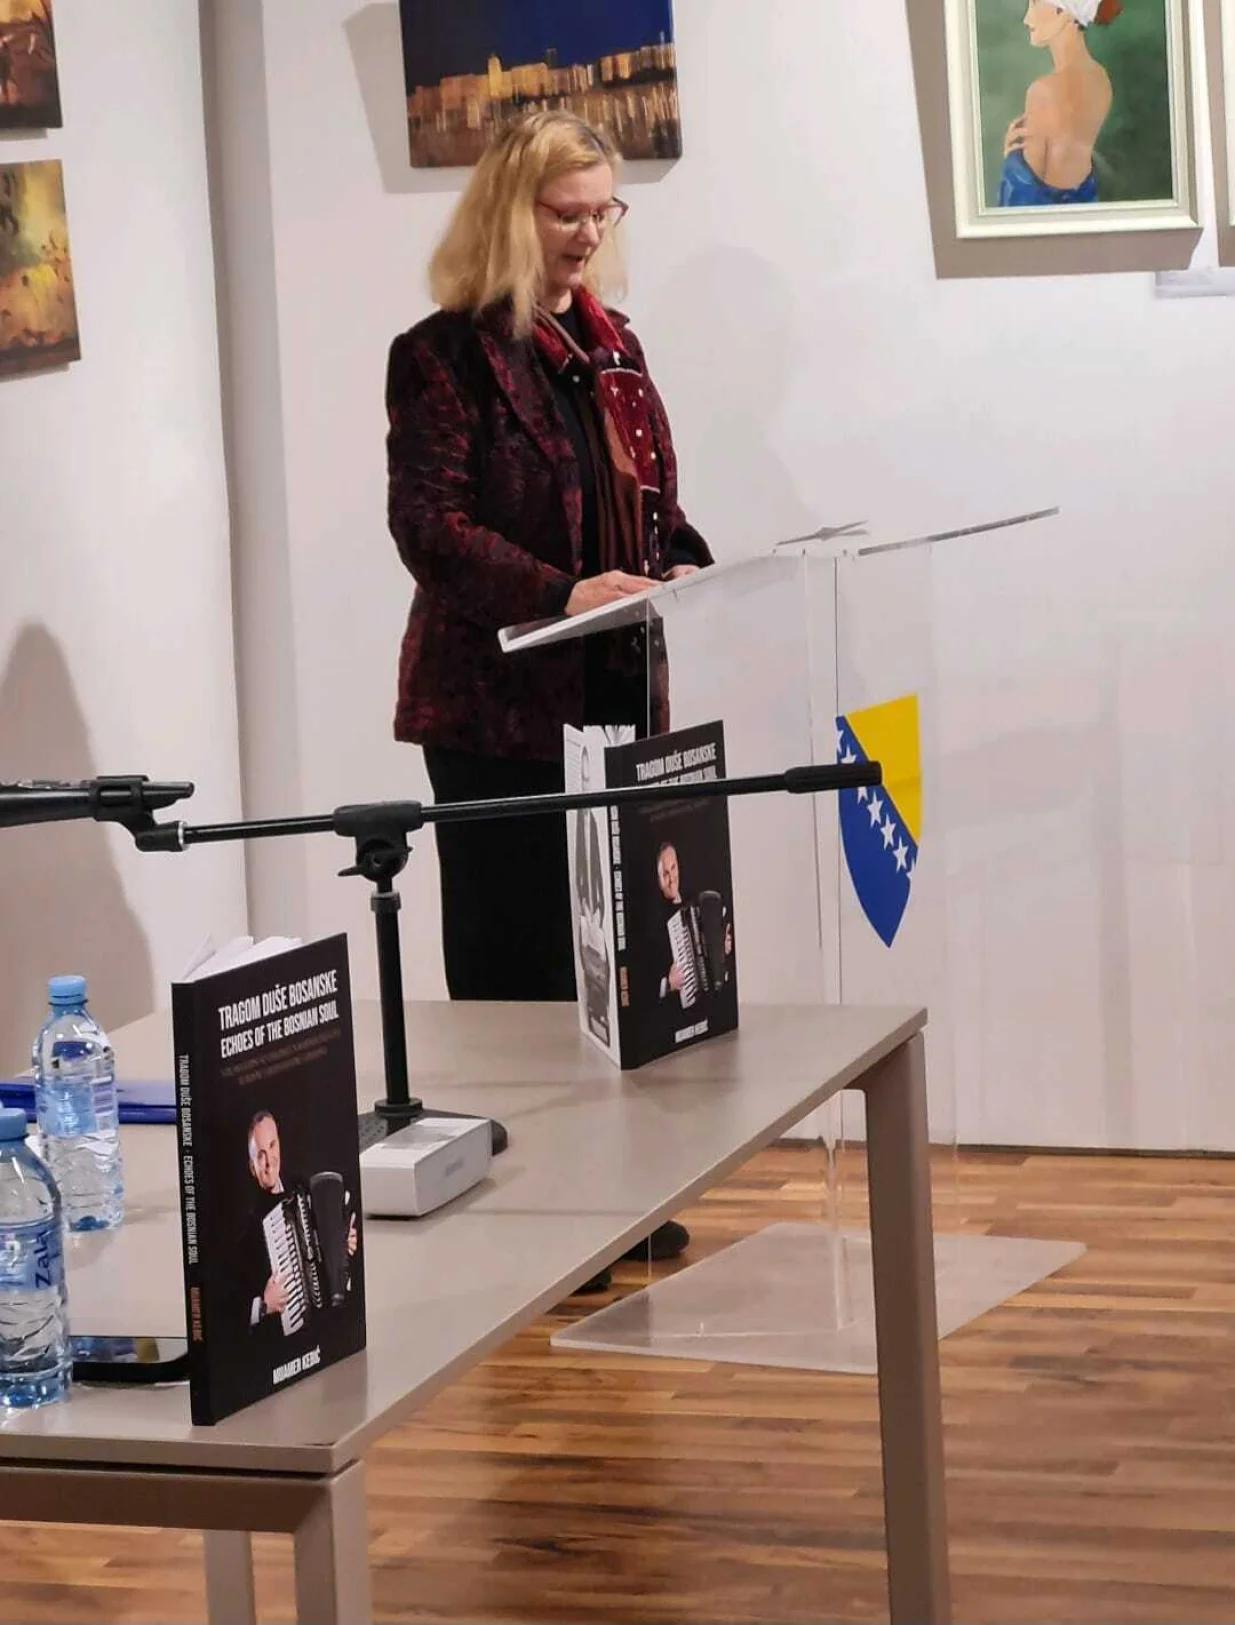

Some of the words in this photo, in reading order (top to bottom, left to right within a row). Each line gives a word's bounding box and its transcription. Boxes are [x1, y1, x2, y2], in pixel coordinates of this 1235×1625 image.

[218, 995, 262, 1031] TRAGOM
[262, 983, 288, 1017] DUŠE
[288, 969, 338, 1007] BOSANSKE
[221, 1029, 254, 1059] ECHOES
[254, 1024, 265, 1047] OF
[266, 1019, 283, 1043] THE
[283, 1006, 319, 1037] BOSNIAN
[318, 1000, 339, 1024] SOUL
